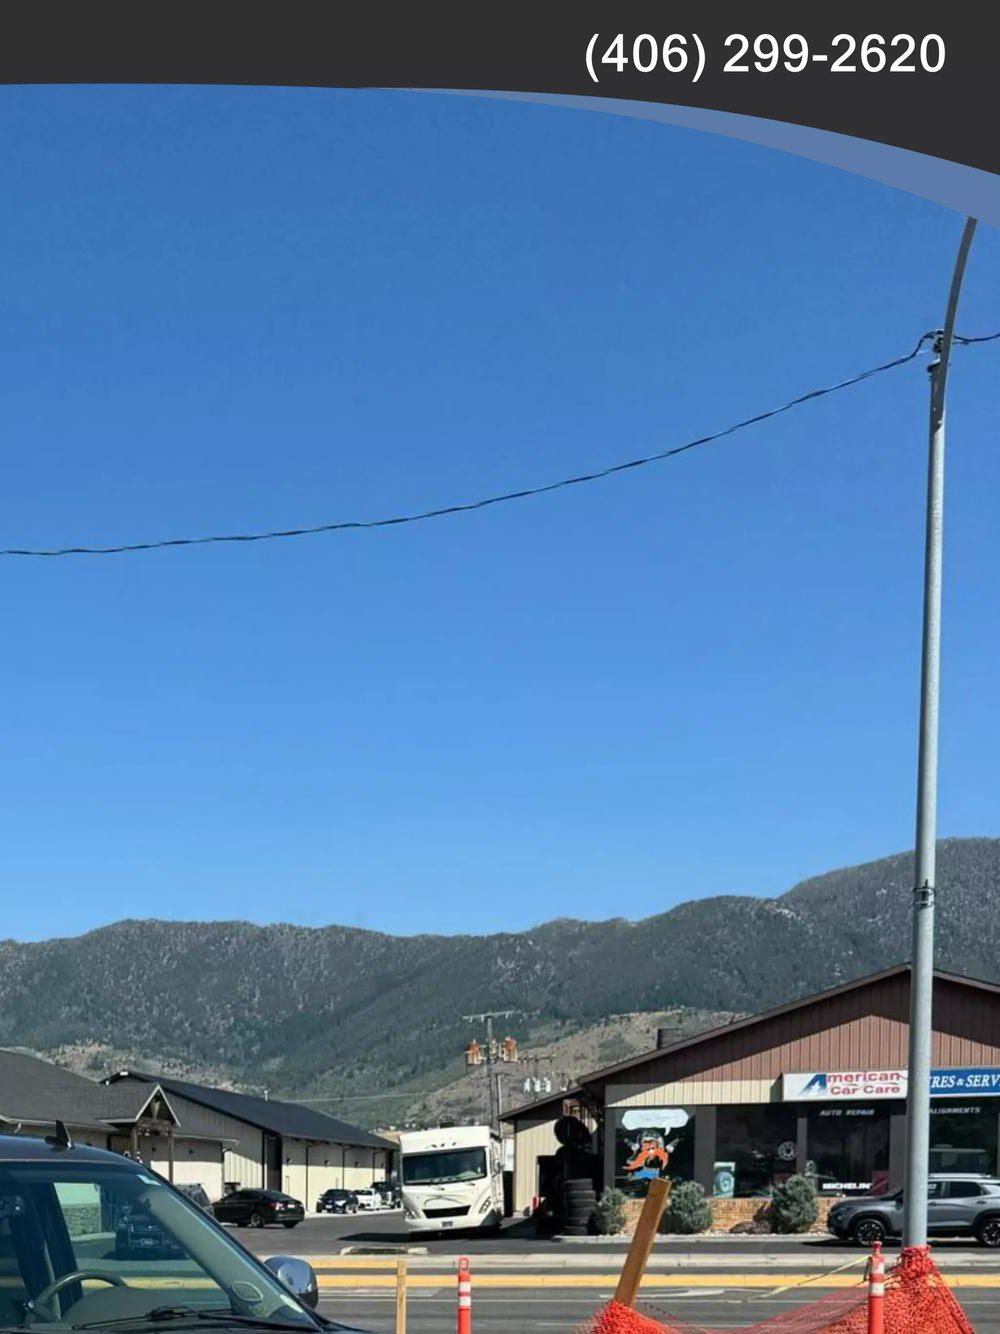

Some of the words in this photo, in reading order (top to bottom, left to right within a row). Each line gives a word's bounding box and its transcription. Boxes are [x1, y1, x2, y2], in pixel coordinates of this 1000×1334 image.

[800, 1072, 901, 1095] American
[929, 1075, 956, 1088] RES
[956, 1078, 965, 1086] &
[965, 1073, 1000, 1088] SERV
[830, 1086, 858, 1095] Car
[863, 1084, 900, 1094] Care
[845, 1108, 875, 1116] REPAIR
[822, 1182, 871, 1190] MICHELIN
